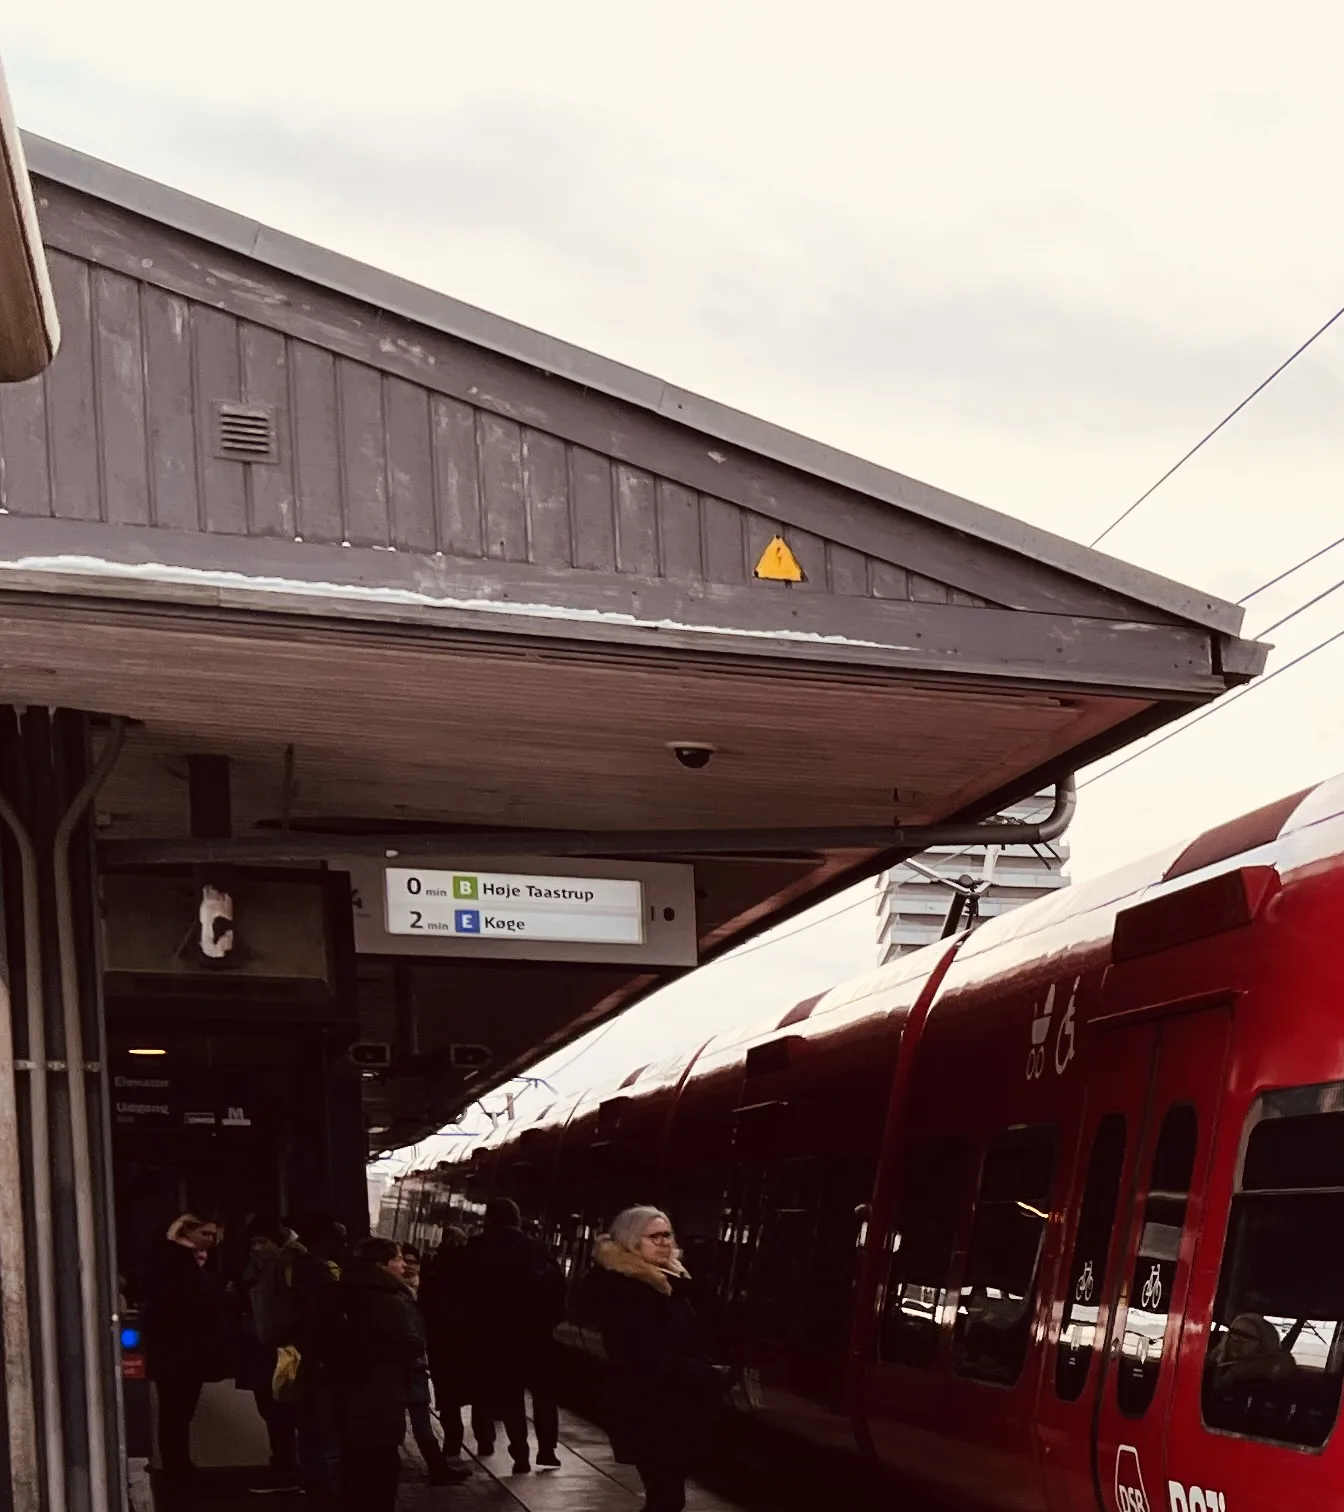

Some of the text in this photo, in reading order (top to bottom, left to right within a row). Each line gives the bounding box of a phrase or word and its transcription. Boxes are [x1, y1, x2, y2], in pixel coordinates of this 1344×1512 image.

[407, 877, 594, 902] 0 min B Høje Taastrup
[409, 911, 525, 932] 2 min E Køge
